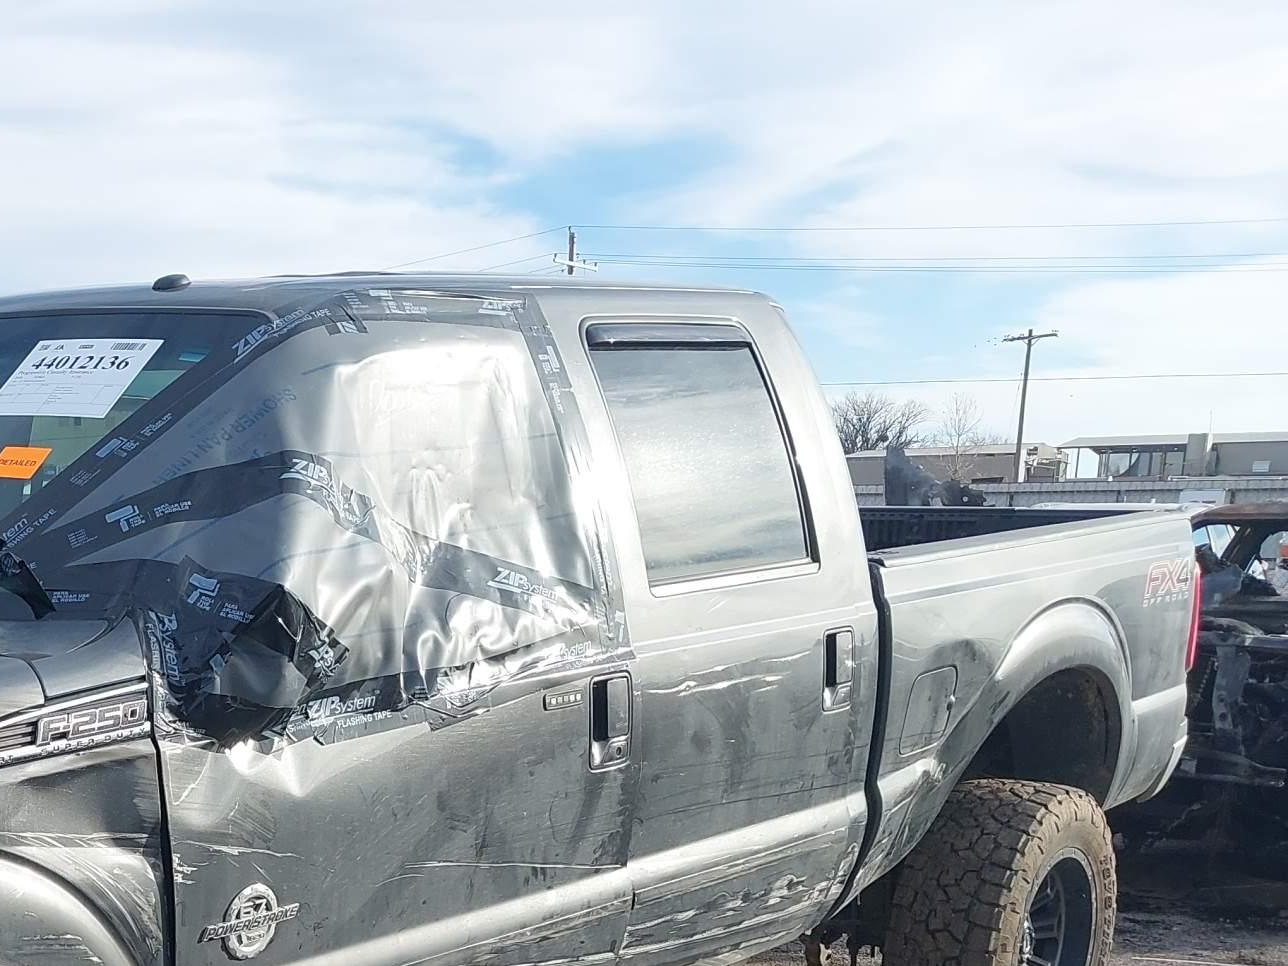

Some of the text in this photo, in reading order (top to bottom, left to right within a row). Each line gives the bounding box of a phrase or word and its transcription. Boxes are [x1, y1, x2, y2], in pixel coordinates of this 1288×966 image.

[32, 355, 136, 370] 44012136
[1144, 557, 1191, 599] FX4
[37, 700, 147, 746] F-250
[337, 709, 393, 729] FLASHING TAPE
[40, 738, 95, 755] SUPER
[104, 727, 146, 743] DUTY
